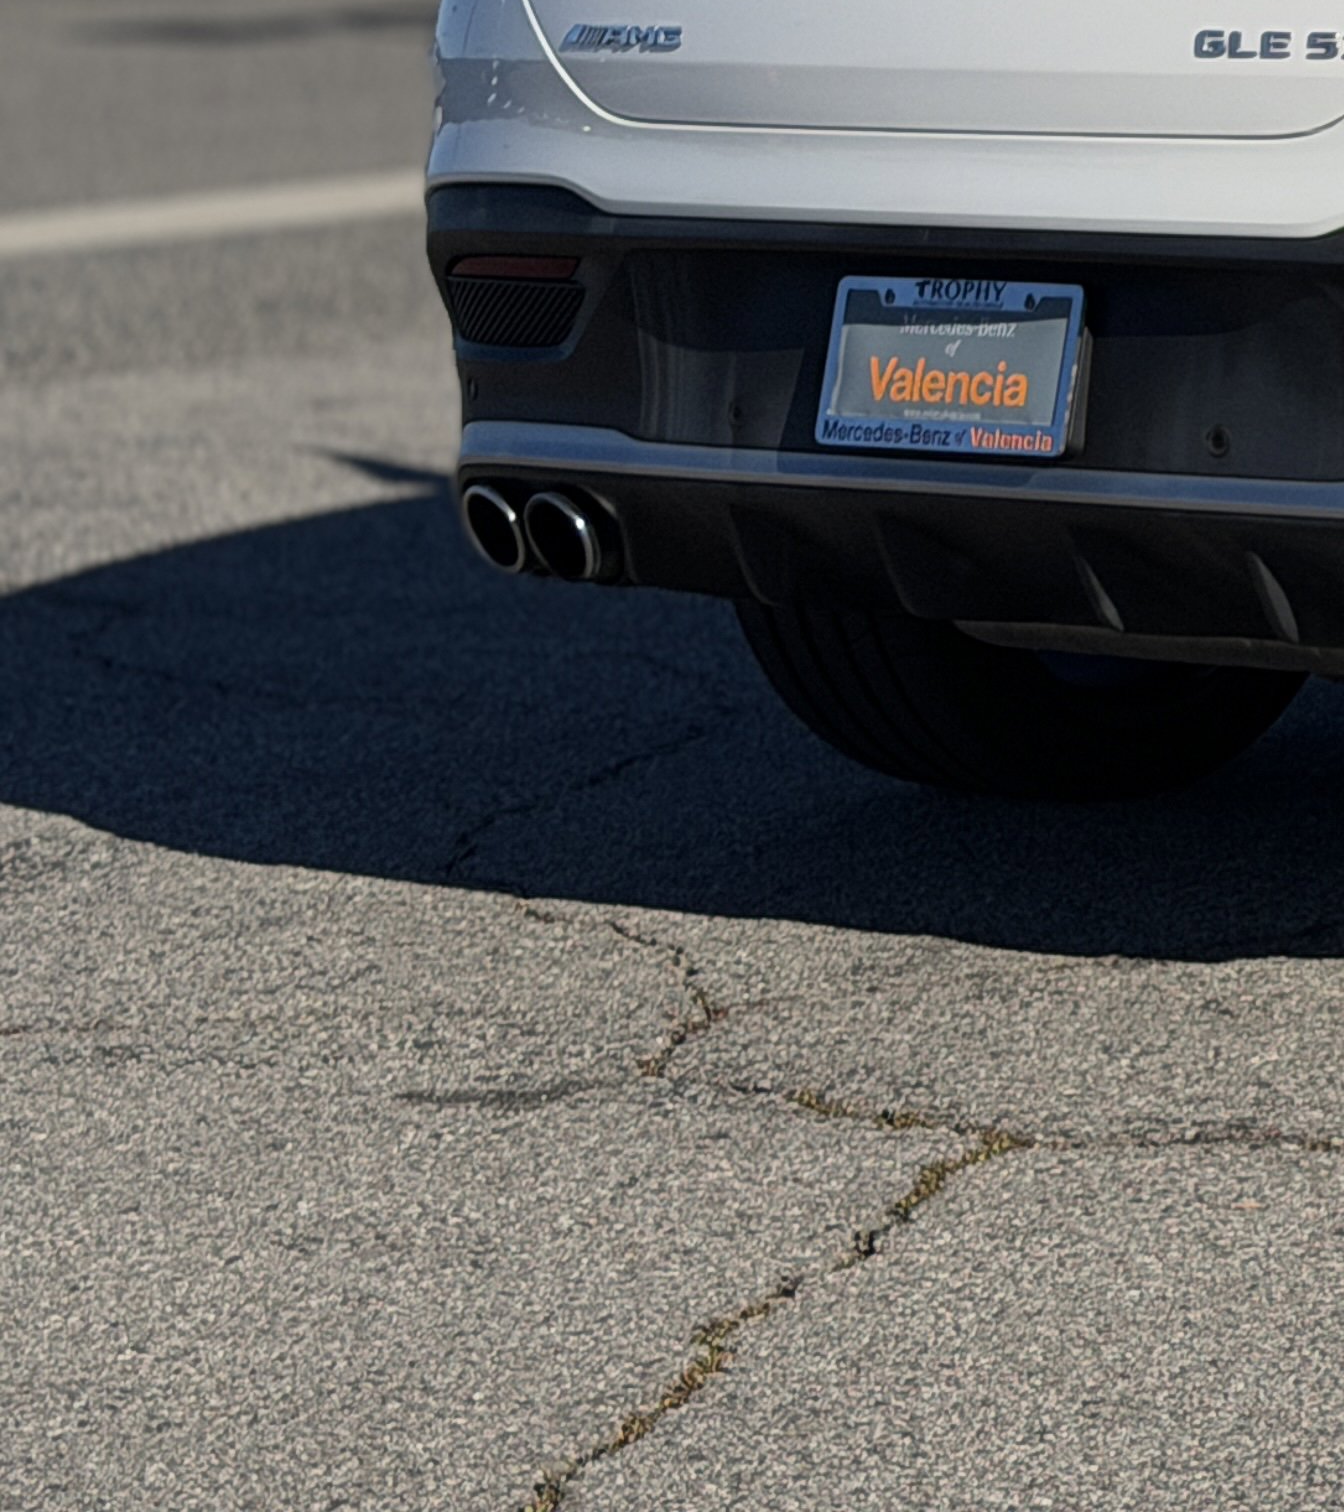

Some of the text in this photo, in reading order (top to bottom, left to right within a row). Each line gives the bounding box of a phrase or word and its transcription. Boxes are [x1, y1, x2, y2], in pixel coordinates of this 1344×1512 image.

[597, 24, 683, 52] AMG
[1194, 29, 1292, 60] GLE
[914, 278, 1008, 303] TROPHY
[945, 339, 962, 358] of
[869, 355, 1029, 408] Valencia
[821, 419, 950, 446] Mercedes-Benz
[970, 426, 1054, 452] Valencia
